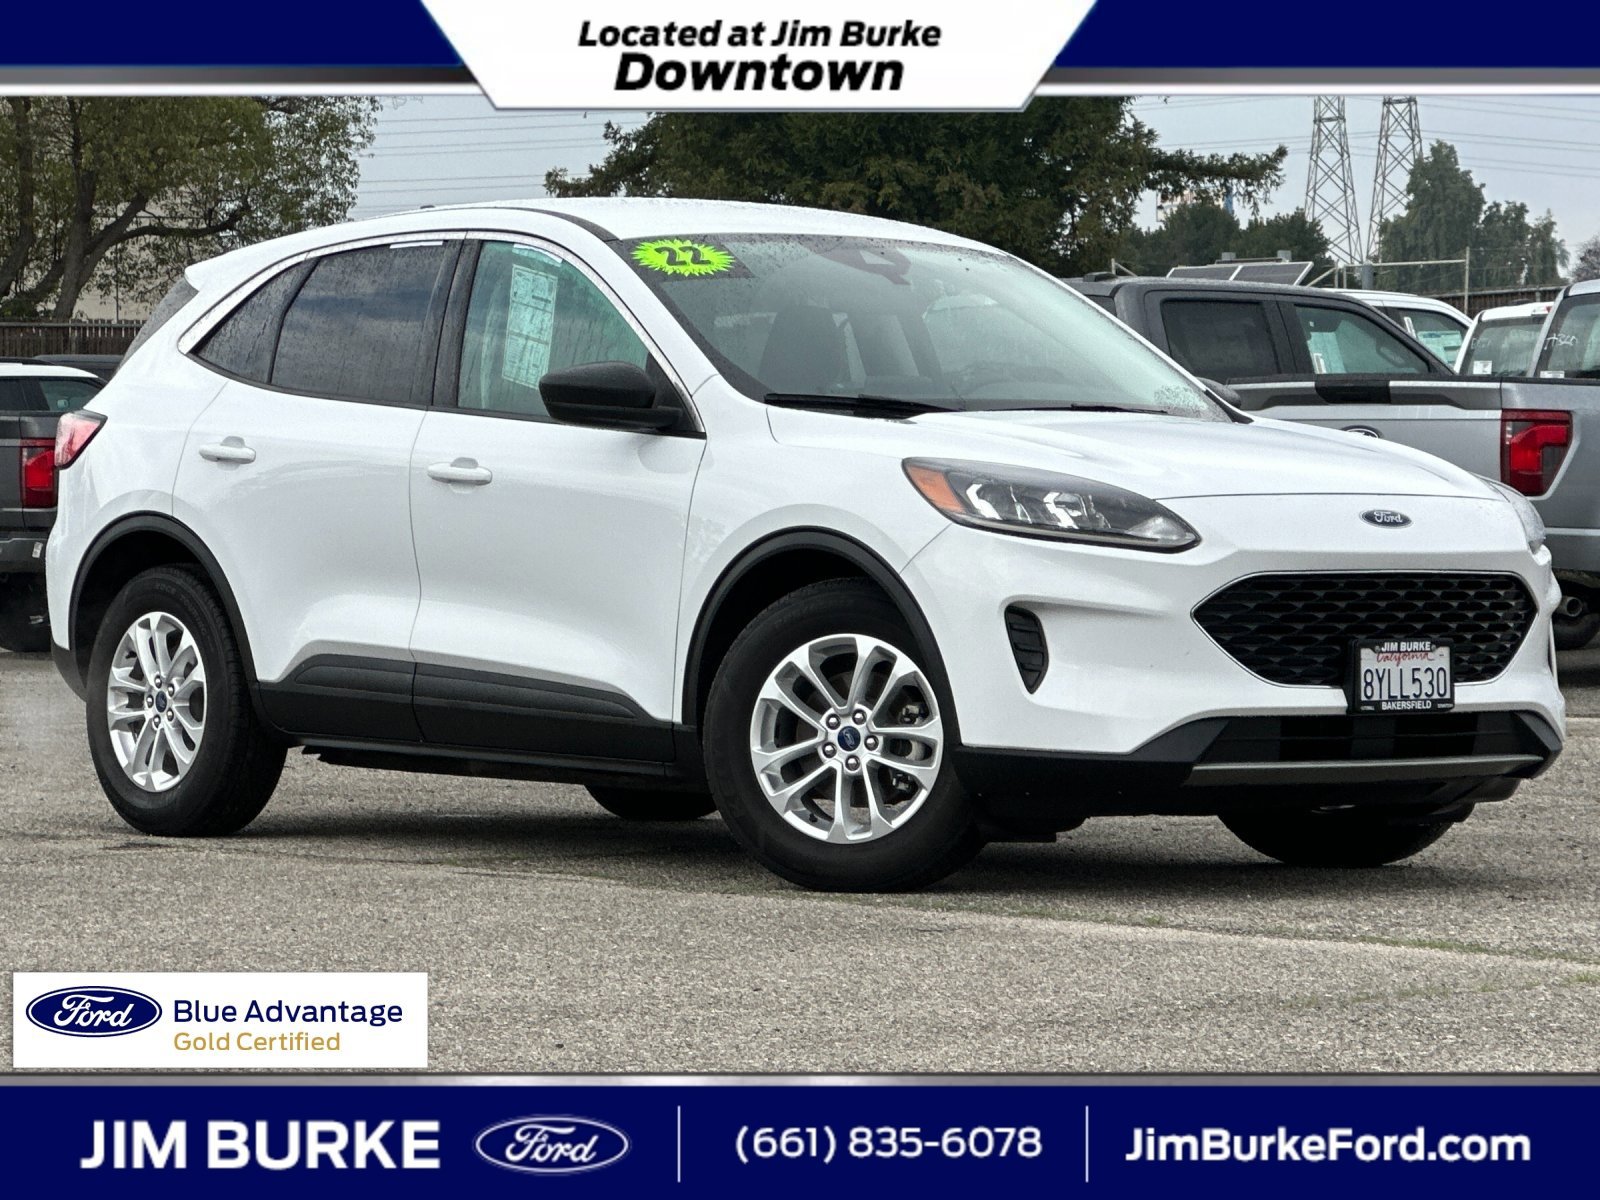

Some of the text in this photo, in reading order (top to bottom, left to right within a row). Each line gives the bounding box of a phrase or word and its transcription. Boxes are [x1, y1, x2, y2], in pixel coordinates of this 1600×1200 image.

[654, 245, 712, 267] 22
[1381, 641, 1431, 652] JIM BURKE
[1363, 667, 1447, 700] 8YLL530
[1381, 701, 1432, 711] BAKERSFIELD
